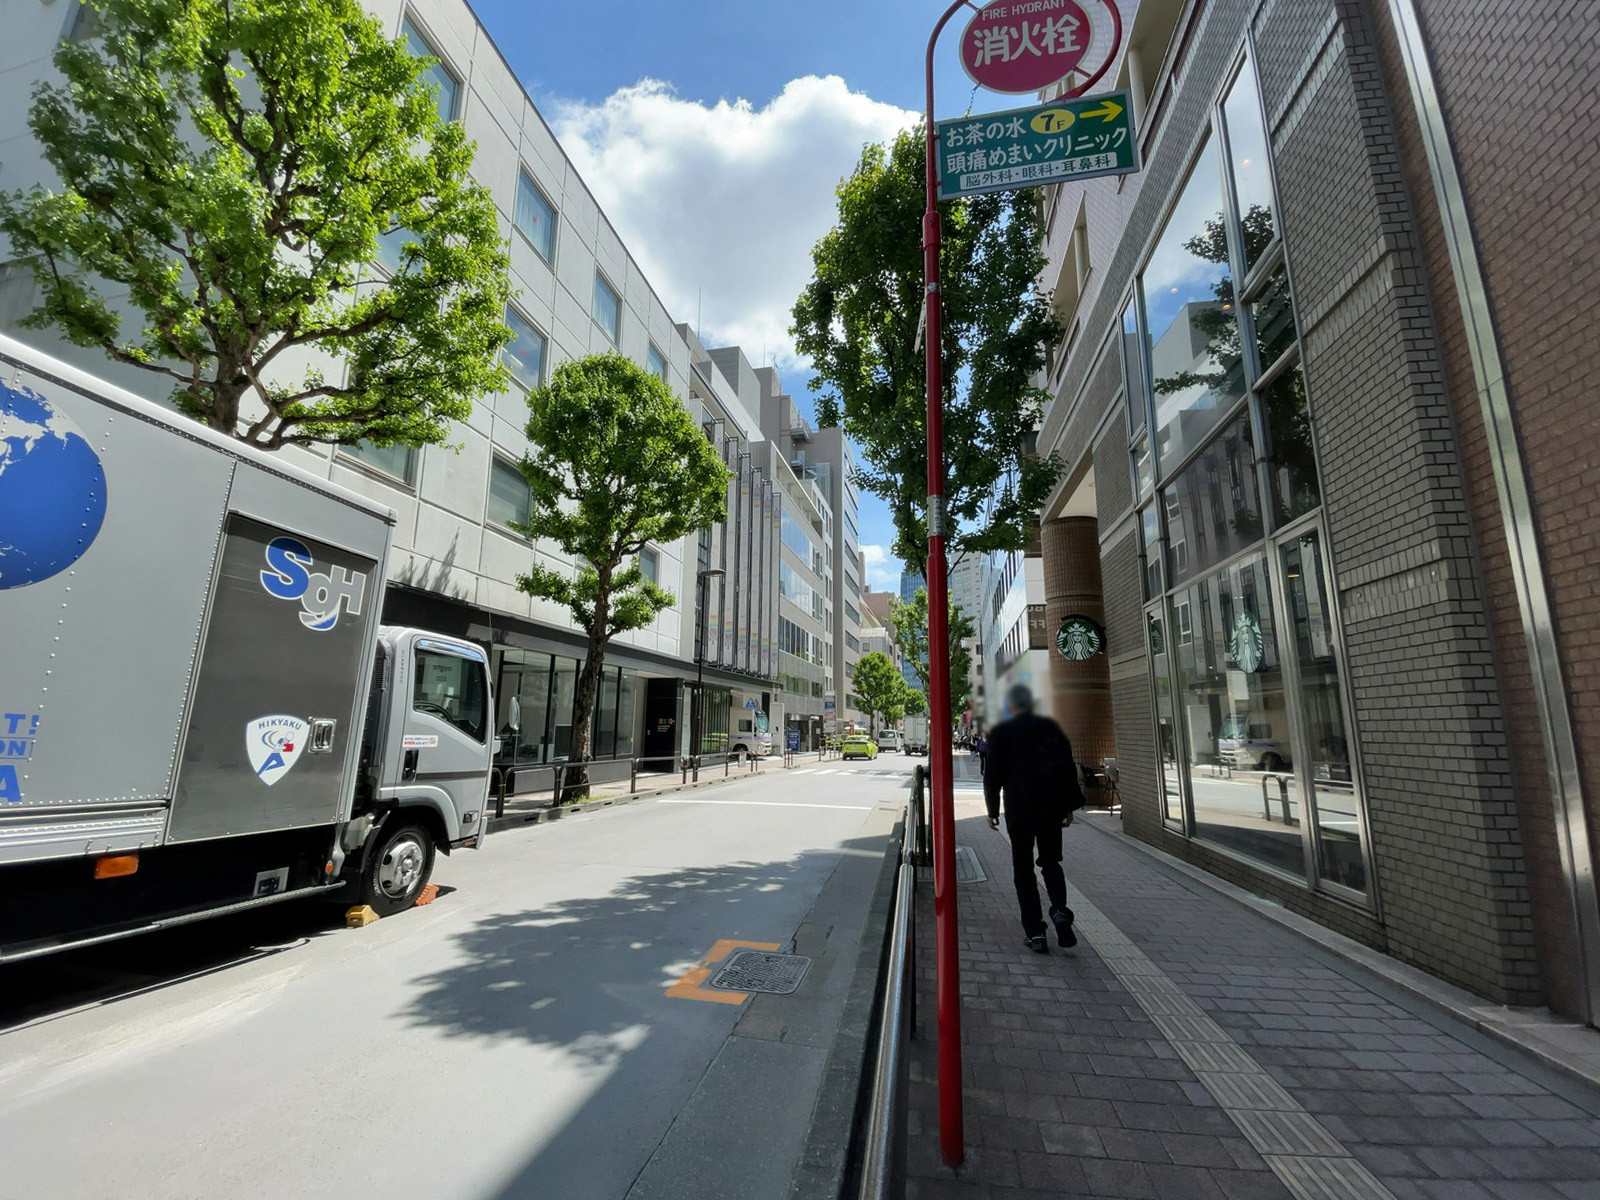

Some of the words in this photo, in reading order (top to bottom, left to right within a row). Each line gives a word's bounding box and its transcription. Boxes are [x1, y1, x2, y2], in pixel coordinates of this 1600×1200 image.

[982, 7, 1008, 22] FIRE
[1011, 0, 1067, 16] HYDRANT
[973, 14, 1081, 67] 消火栓
[946, 116, 1027, 147] お茶の水
[1040, 112, 1065, 132] 7F
[946, 127, 1128, 175] 頭痛めまいクリニック
[965, 154, 1111, 188] 脳外科・眼科・耳鼻科
[258, 718, 302, 731] HIKYAKU
